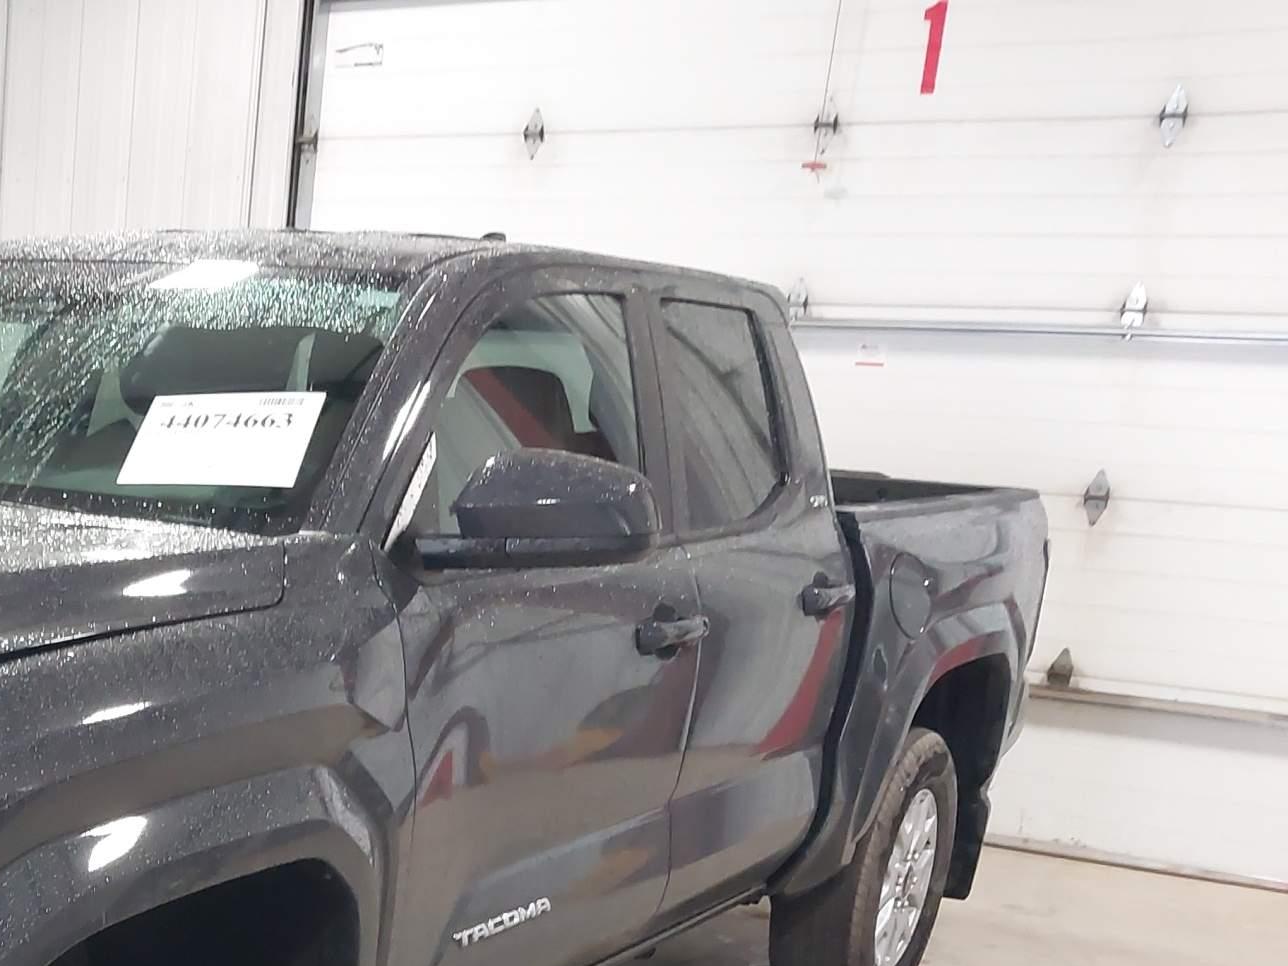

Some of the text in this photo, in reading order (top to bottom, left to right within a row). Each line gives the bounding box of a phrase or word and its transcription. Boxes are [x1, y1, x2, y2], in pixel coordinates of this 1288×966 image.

[920, 0, 948, 94] 1
[160, 412, 293, 429] 44074663
[452, 897, 551, 947] TACOMA
